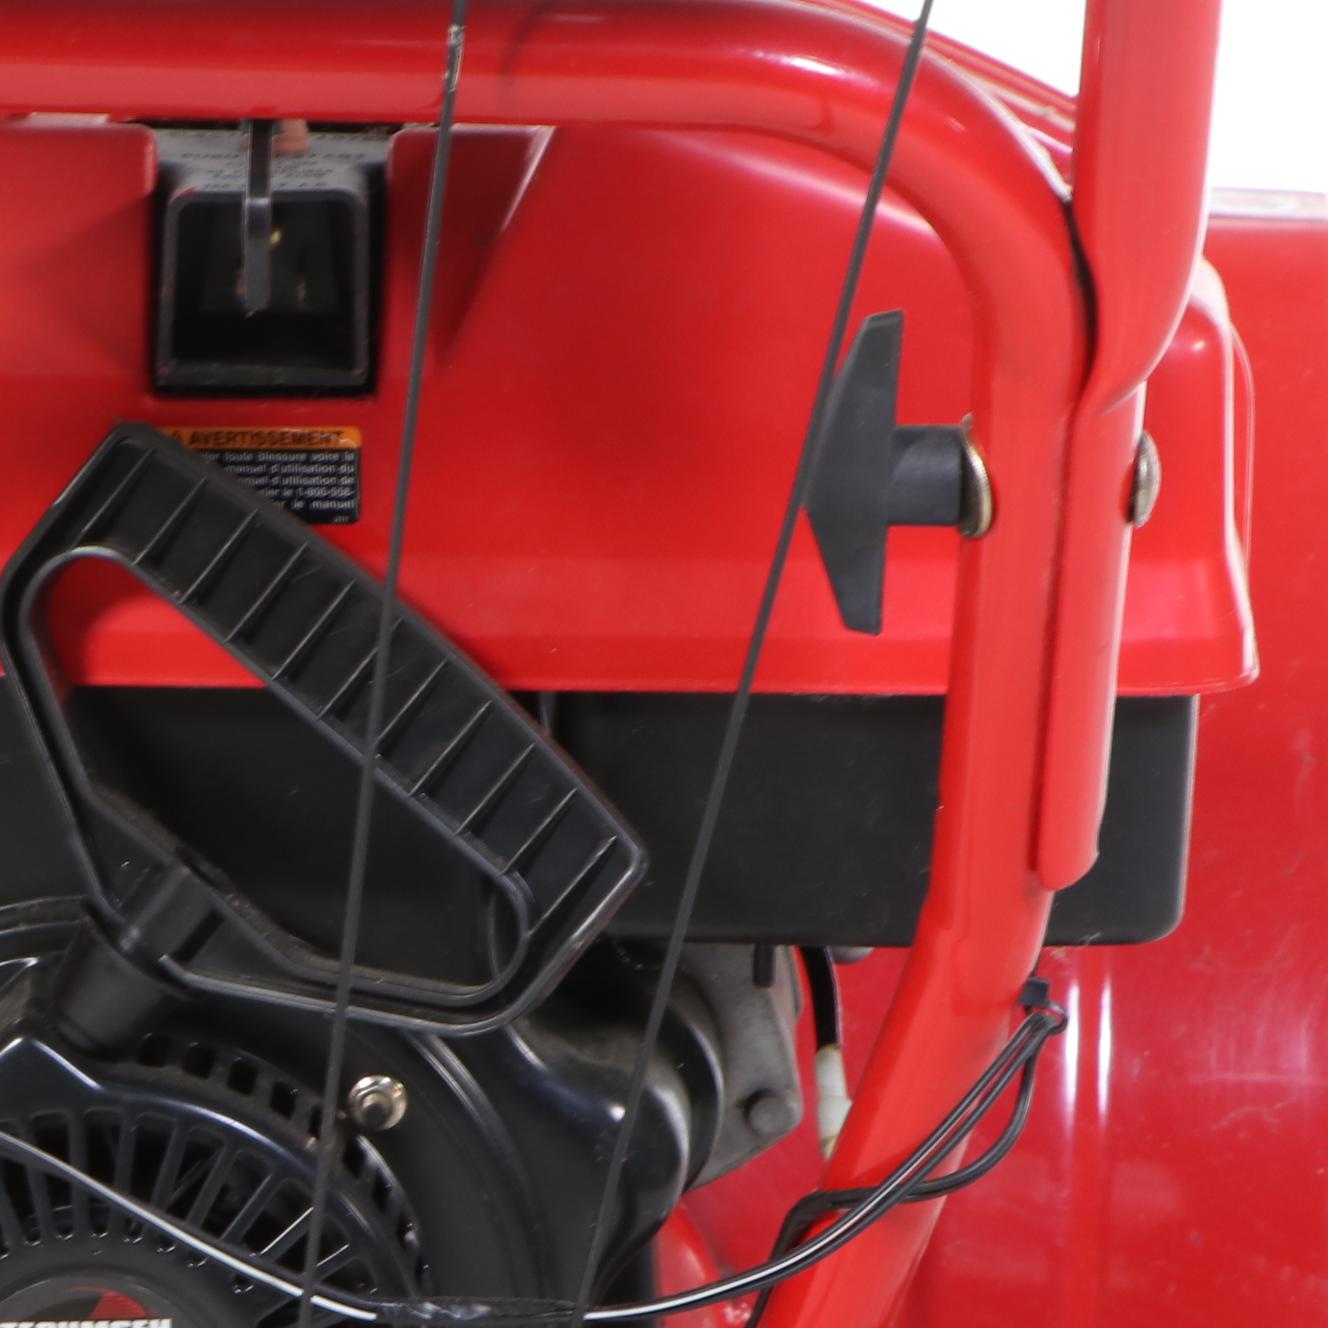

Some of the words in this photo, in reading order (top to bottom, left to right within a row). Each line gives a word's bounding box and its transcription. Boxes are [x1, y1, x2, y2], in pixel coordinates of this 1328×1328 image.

[189, 431, 344, 446] AVERTISSEMENT
[340, 464, 354, 473] du
[311, 499, 354, 509] manuel
